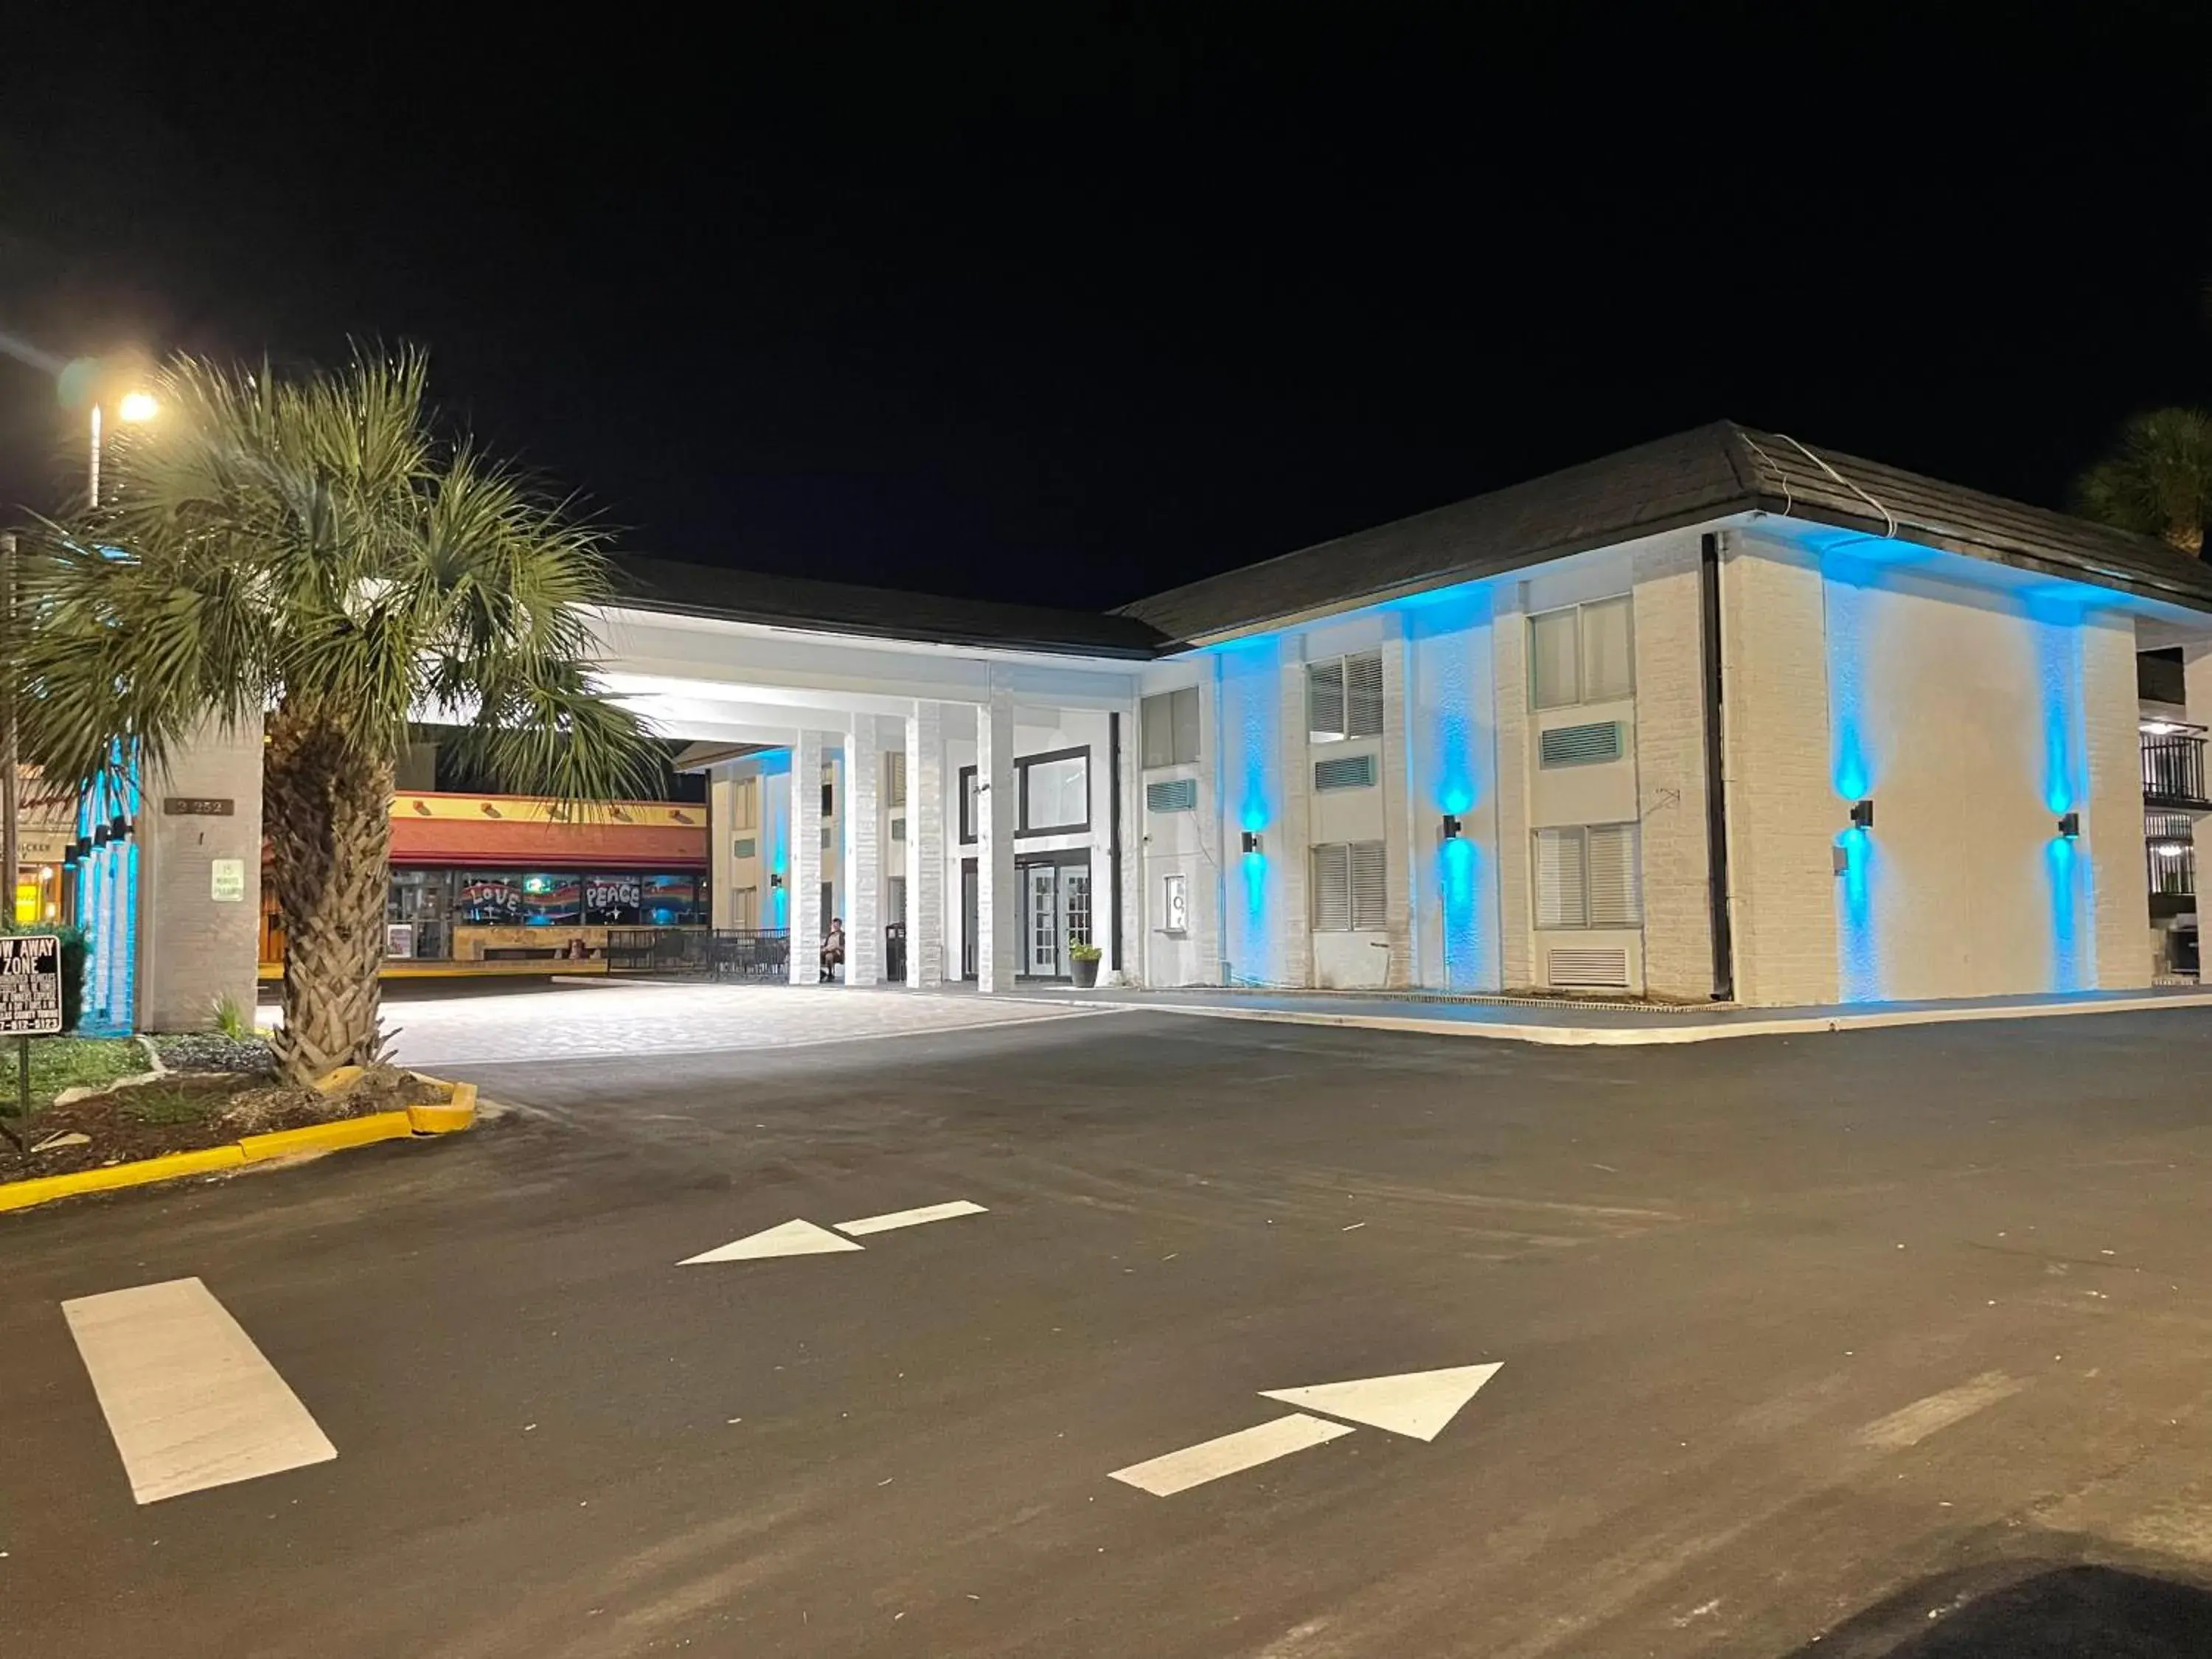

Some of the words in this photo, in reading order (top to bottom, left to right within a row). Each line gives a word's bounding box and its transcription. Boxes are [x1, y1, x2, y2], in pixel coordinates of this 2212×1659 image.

[470, 888, 521, 911] LOVE
[586, 884, 640, 908] PEACE
[0, 941, 14, 958] W
[20, 939, 55, 957] AWAY
[3, 956, 39, 975] ZONE
